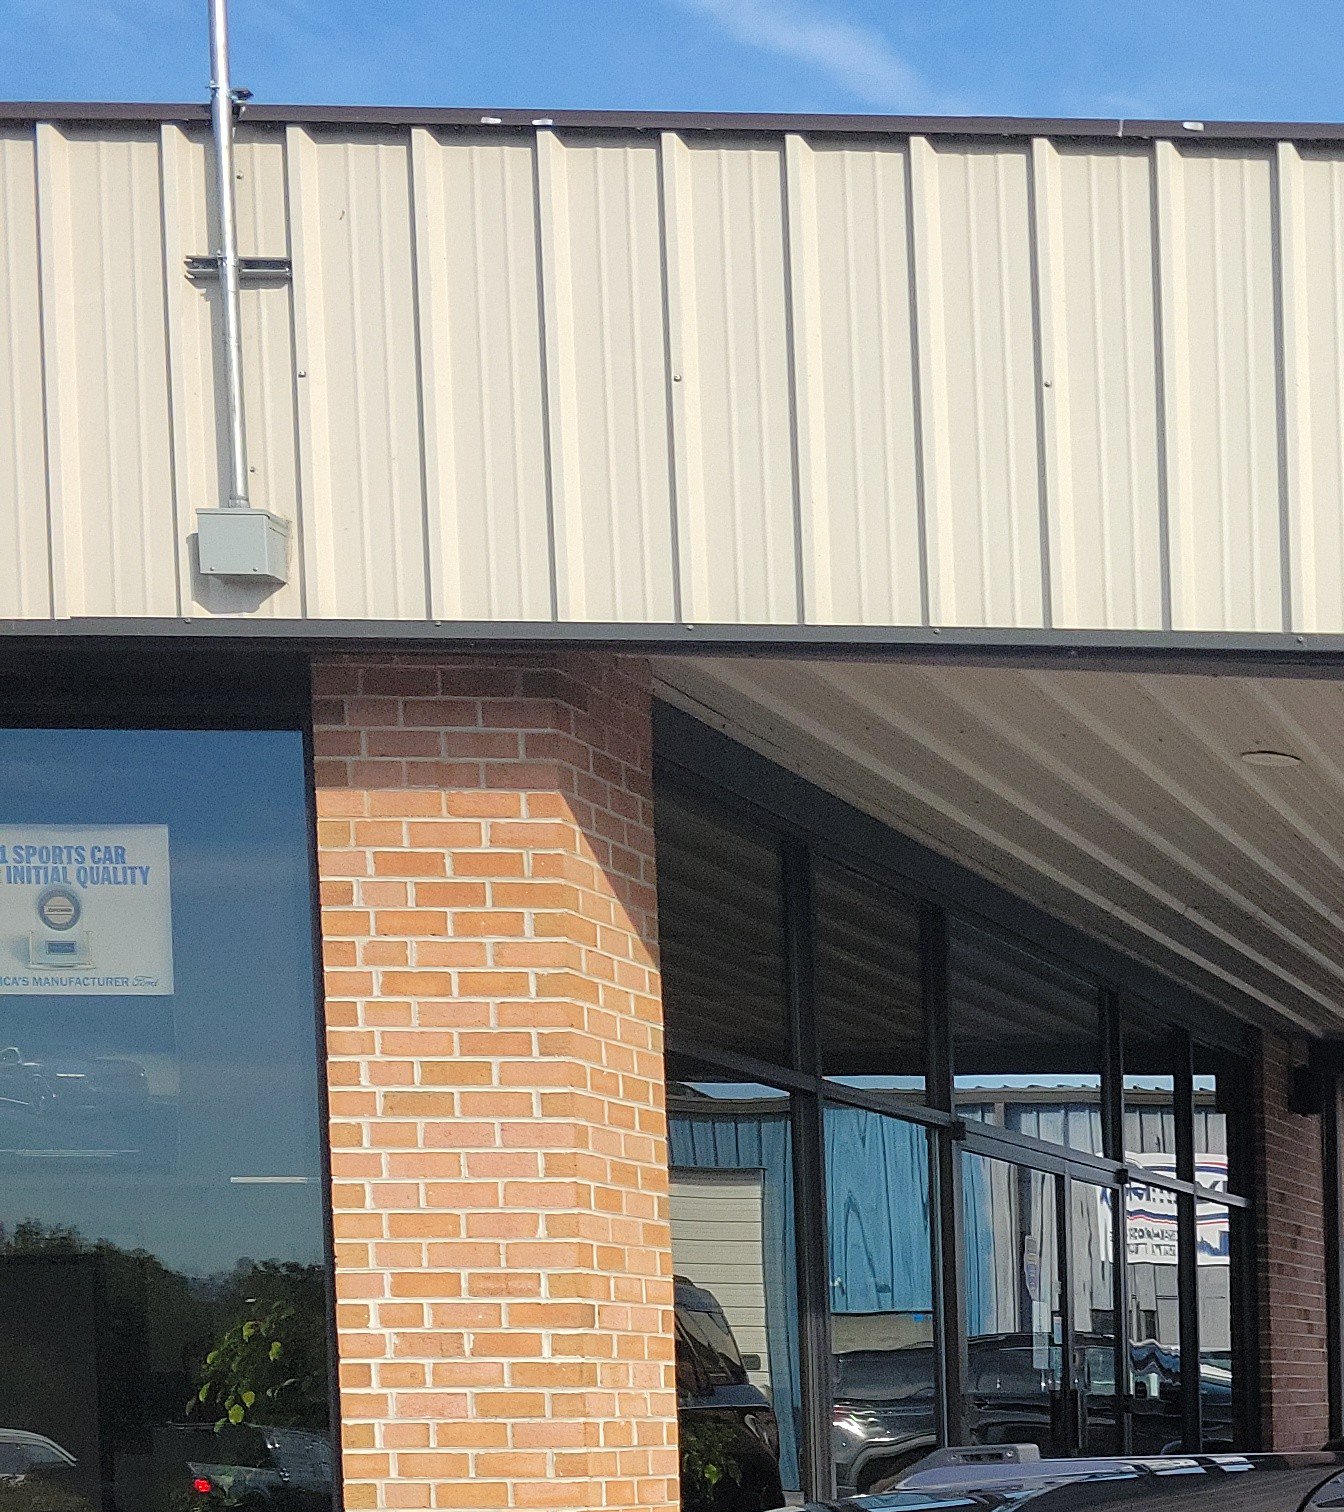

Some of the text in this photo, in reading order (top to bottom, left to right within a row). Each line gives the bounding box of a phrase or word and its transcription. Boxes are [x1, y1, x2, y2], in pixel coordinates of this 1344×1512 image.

[12, 845, 86, 865] SPORTS
[90, 845, 126, 865] CAR
[6, 865, 150, 889] INITIAL QUALITY
[32, 976, 129, 987] MANUFACTURER
[132, 975, 159, 987] Ford
